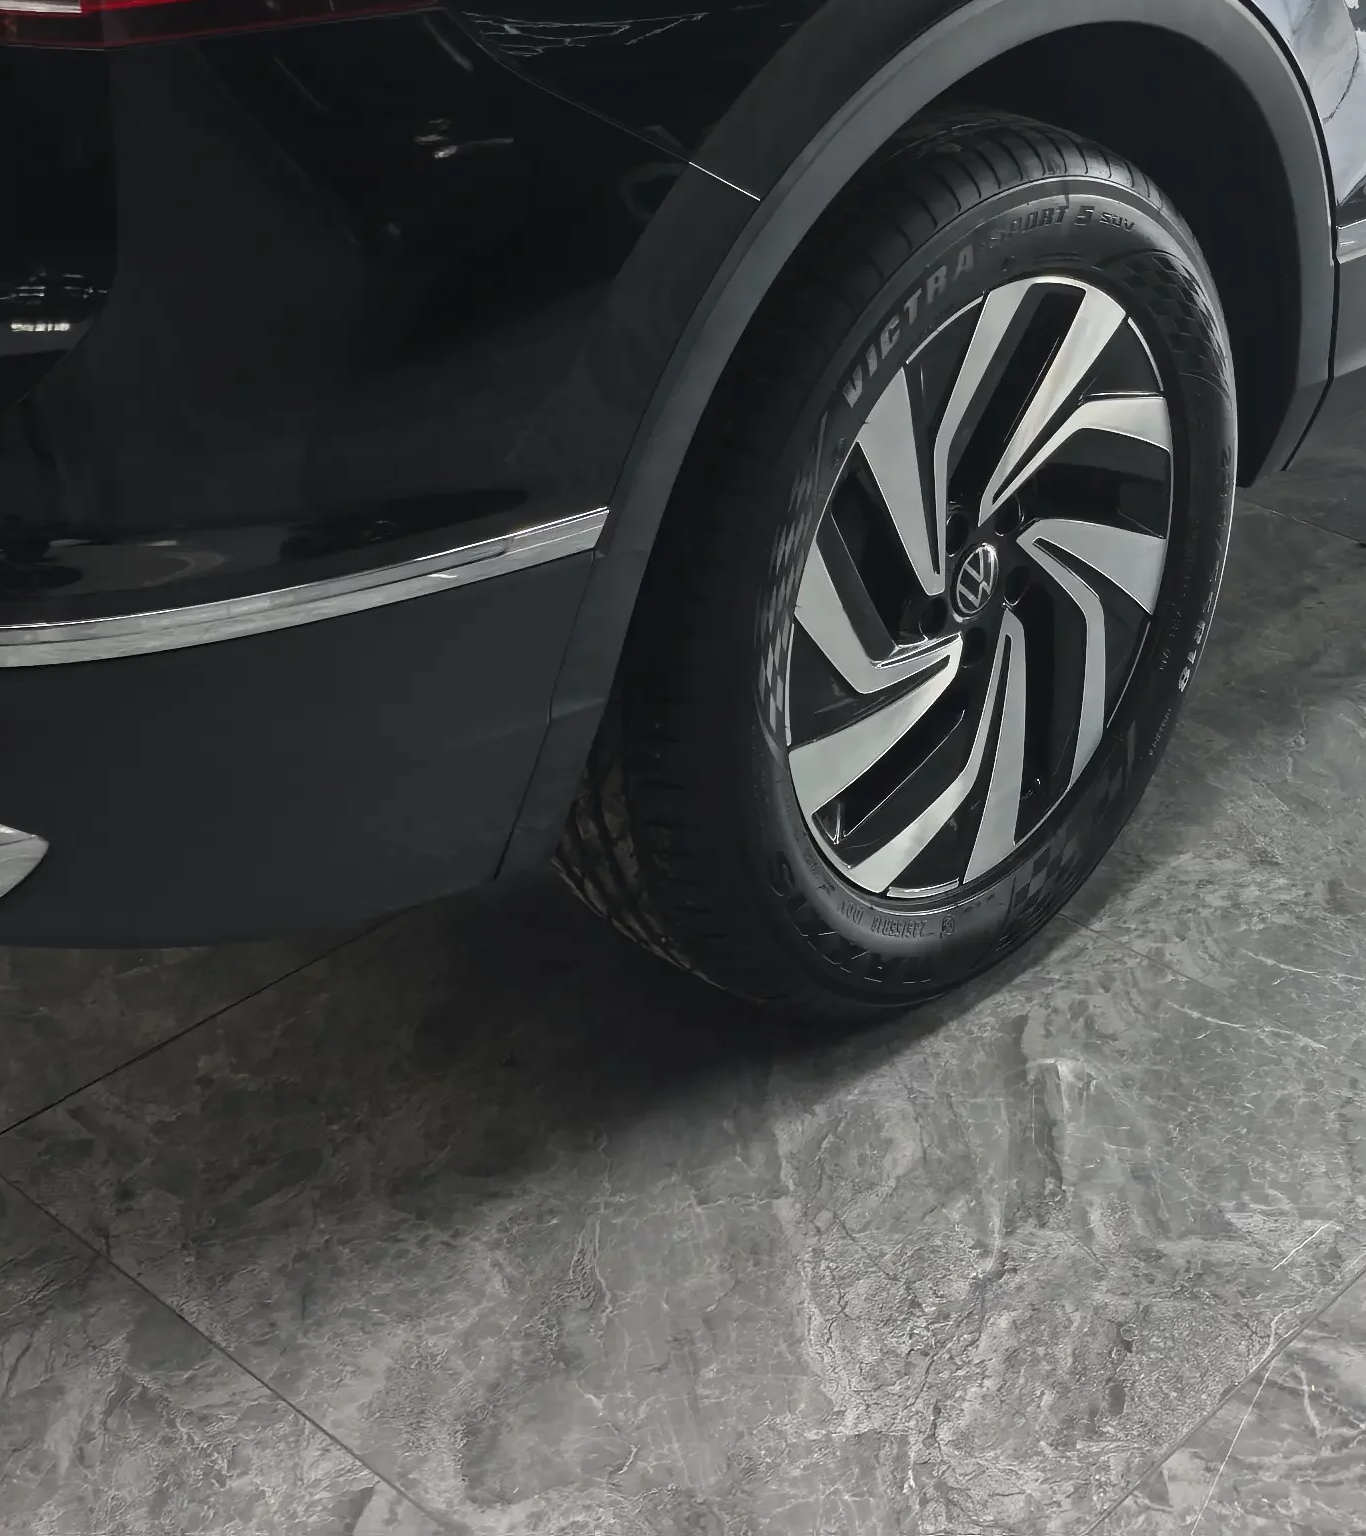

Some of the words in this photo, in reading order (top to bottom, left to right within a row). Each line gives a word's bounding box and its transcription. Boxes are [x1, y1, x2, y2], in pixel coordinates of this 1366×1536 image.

[842, 244, 975, 408] VICTRA
[1074, 205, 1096, 226] 5
[1098, 211, 1135, 232] SUV
